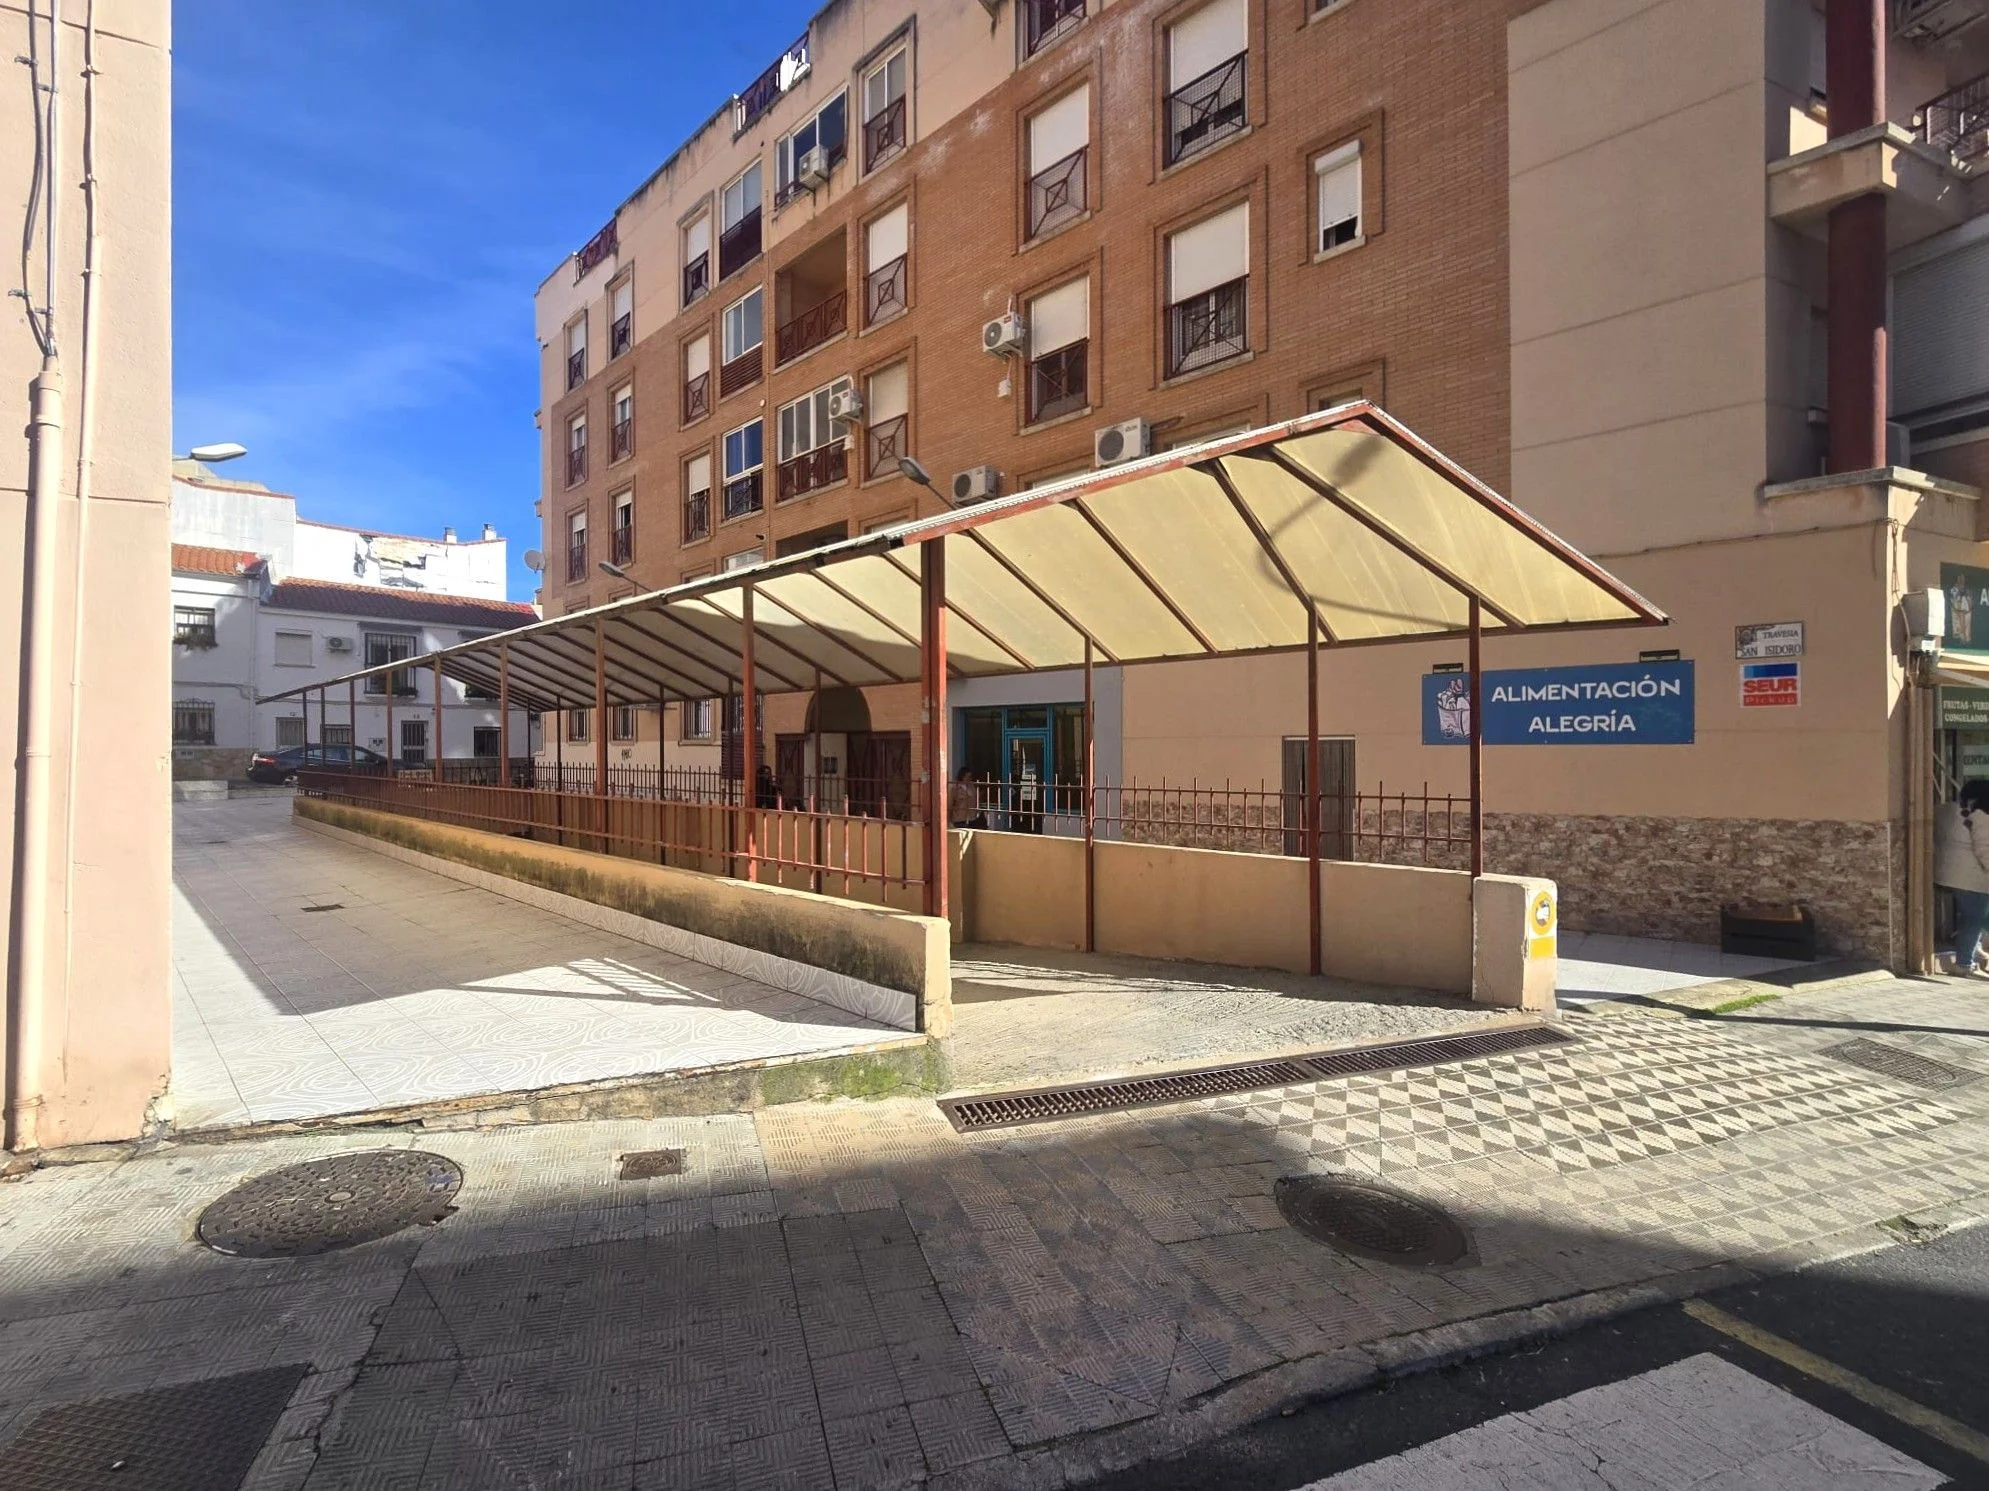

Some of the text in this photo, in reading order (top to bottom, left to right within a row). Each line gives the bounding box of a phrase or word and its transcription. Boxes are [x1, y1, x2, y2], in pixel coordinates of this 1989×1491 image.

[1740, 644, 1802, 656] SAN ISIDORO
[1491, 674, 1681, 702] ALIMENTACIÓN
[1743, 678, 1798, 693] SEUR
[1528, 710, 1637, 733] ALEGRÍA
